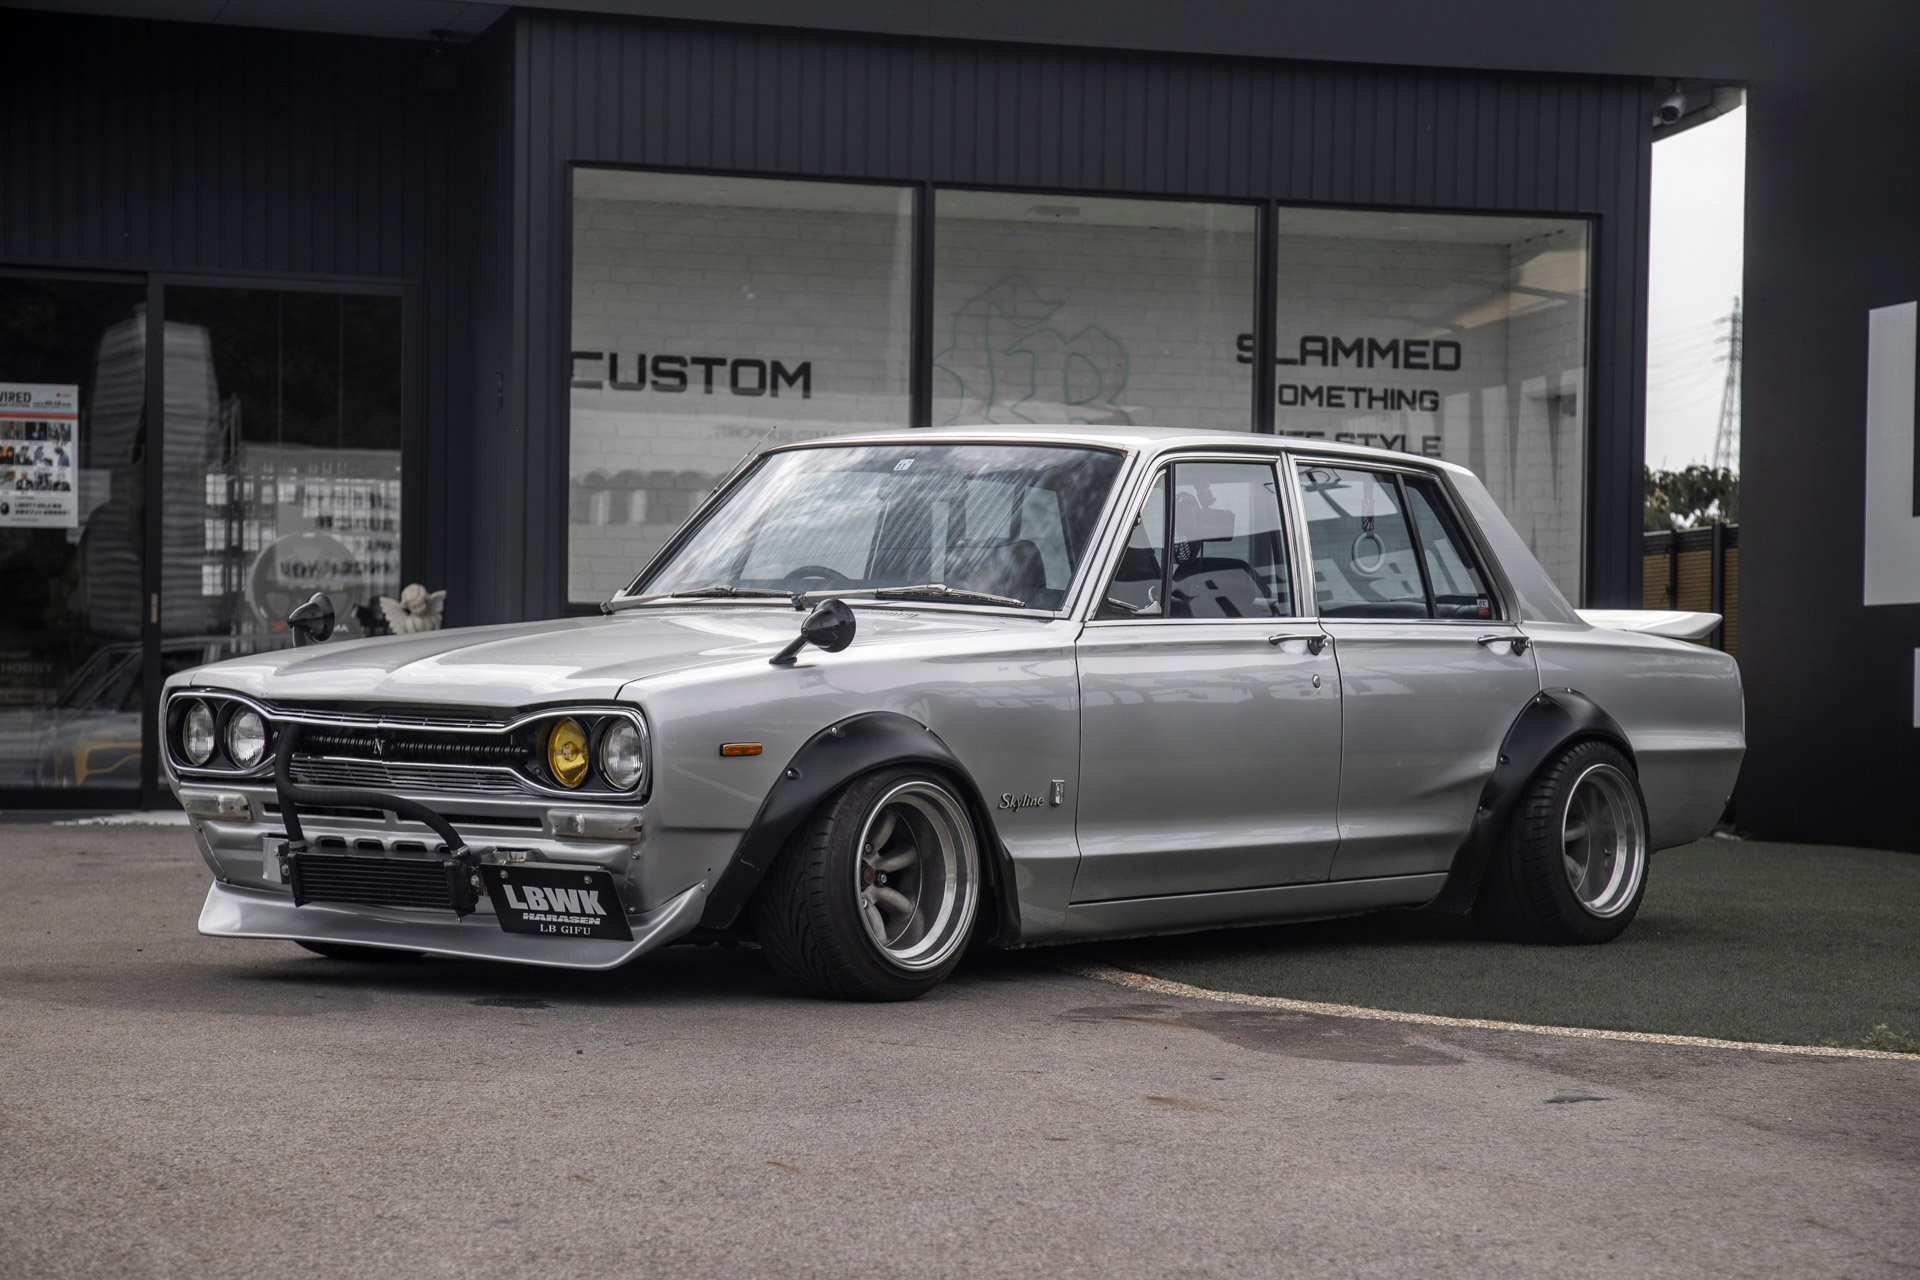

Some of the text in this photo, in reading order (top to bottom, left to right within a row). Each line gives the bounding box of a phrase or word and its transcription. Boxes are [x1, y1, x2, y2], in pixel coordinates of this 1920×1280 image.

[1237, 333, 1462, 371] SAMMED
[570, 351, 811, 399] CUSTOM
[1278, 383, 1440, 412] OMETHING
[998, 792, 1045, 812] Skyline
[502, 884, 607, 916] LBWK
[522, 912, 601, 925] HARASEN
[540, 923, 592, 936] LB GIFU
